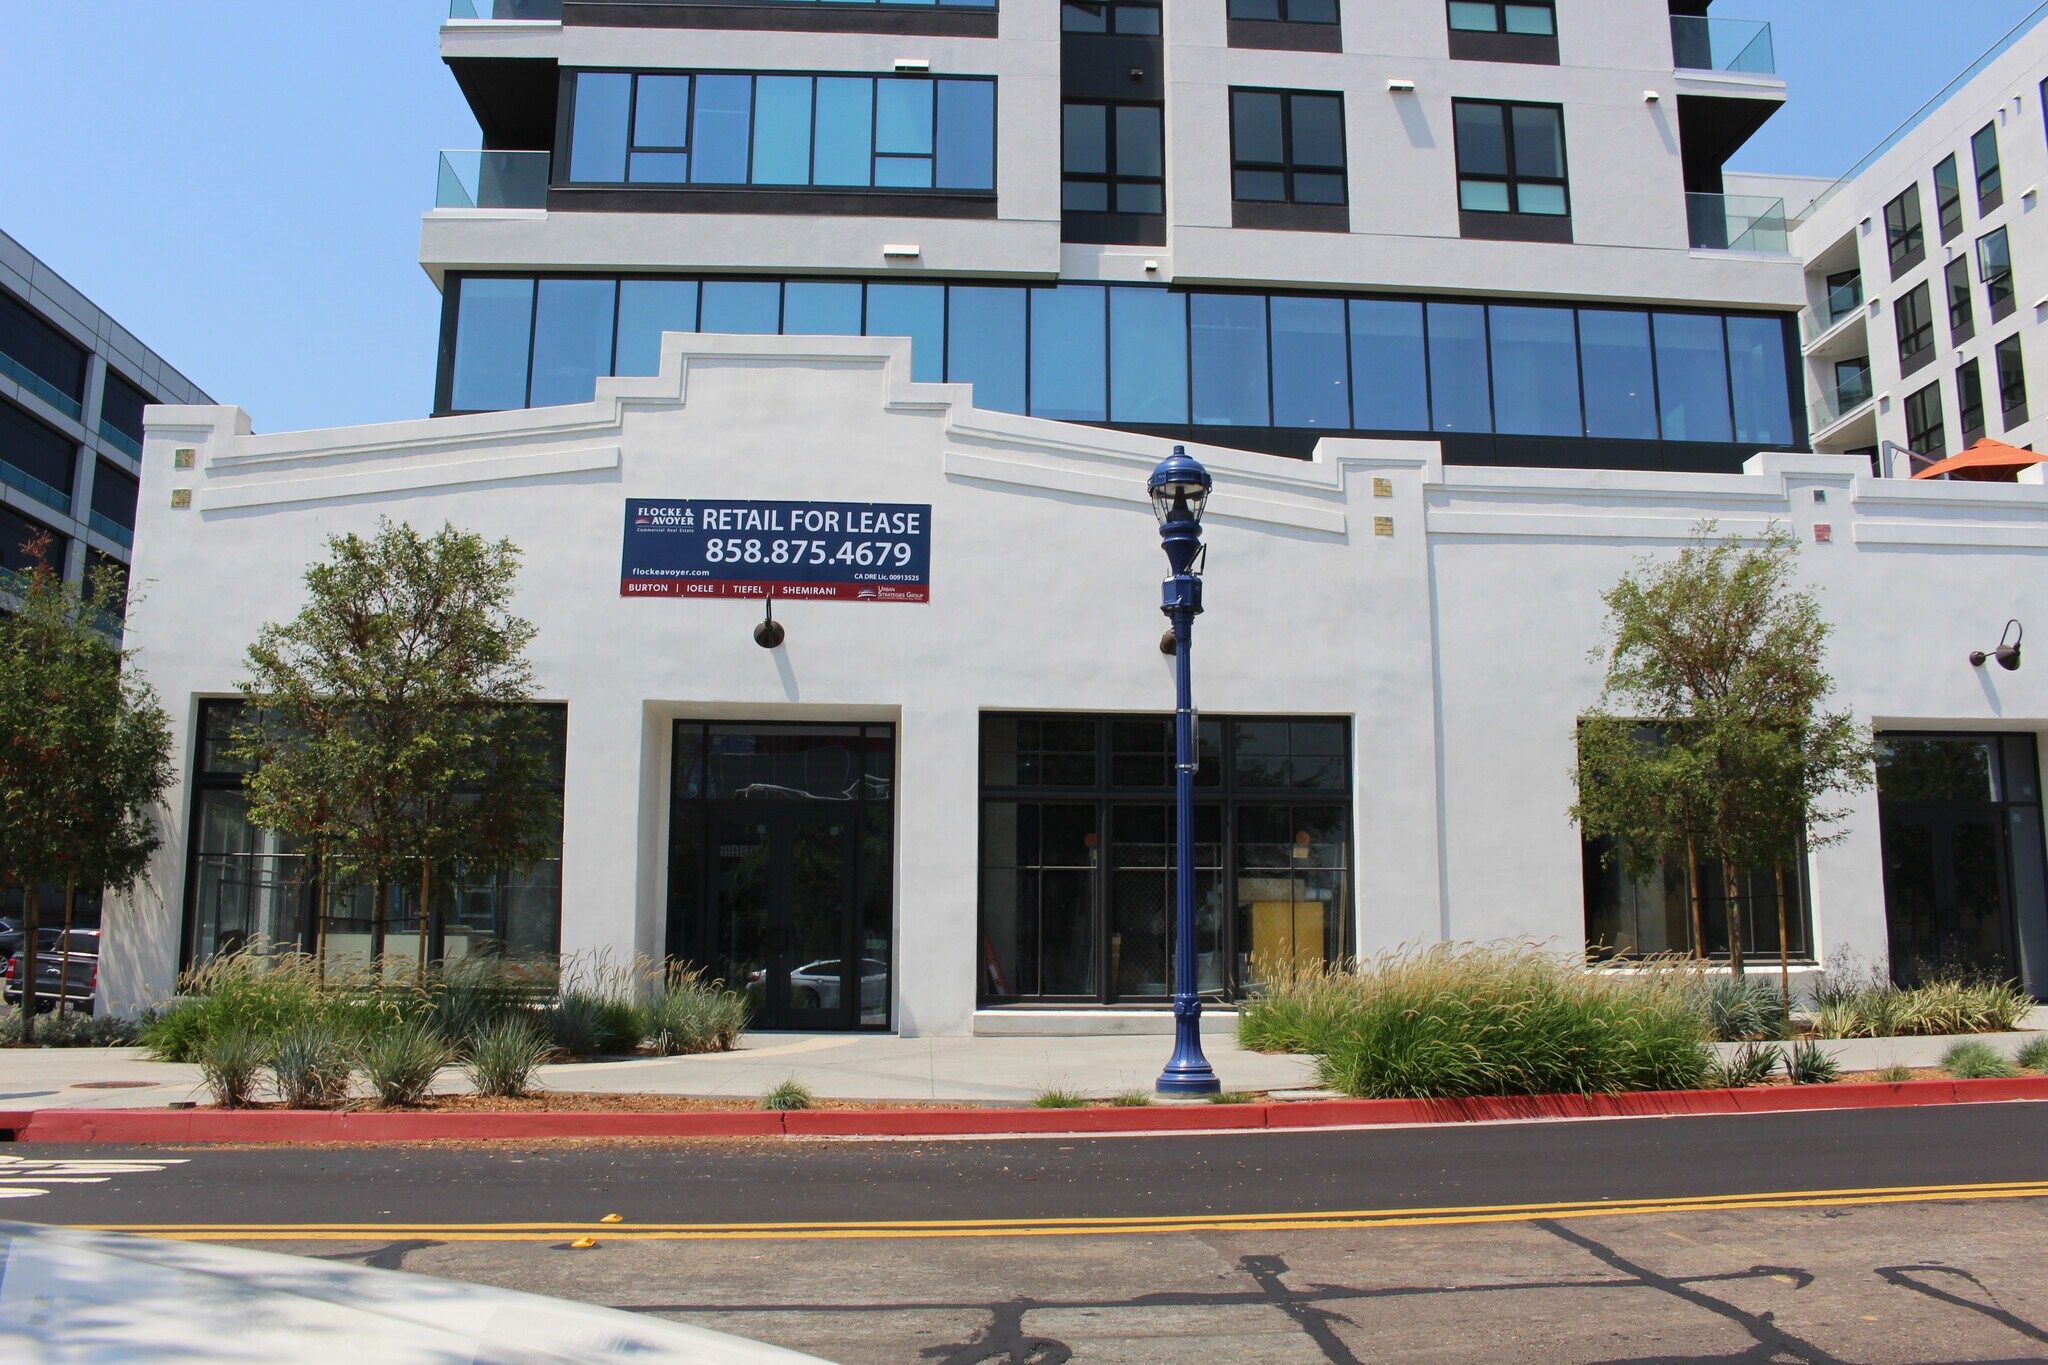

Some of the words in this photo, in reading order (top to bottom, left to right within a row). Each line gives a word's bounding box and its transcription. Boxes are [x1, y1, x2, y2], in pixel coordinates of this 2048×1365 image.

[638, 507, 682, 517] FLOCKE
[685, 508, 694, 517] &
[651, 516, 694, 526] AVOYER
[702, 508, 784, 531] RETAIL
[790, 510, 839, 532] FOR
[846, 511, 920, 535] LEASE
[705, 538, 911, 567] 858.875.4679
[632, 568, 710, 577] flockeavoyer.com
[628, 583, 669, 592] BURTON
[686, 584, 714, 593] IOELE
[733, 585, 763, 594] TIEFEL
[782, 586, 836, 595] SHEMIRANI
